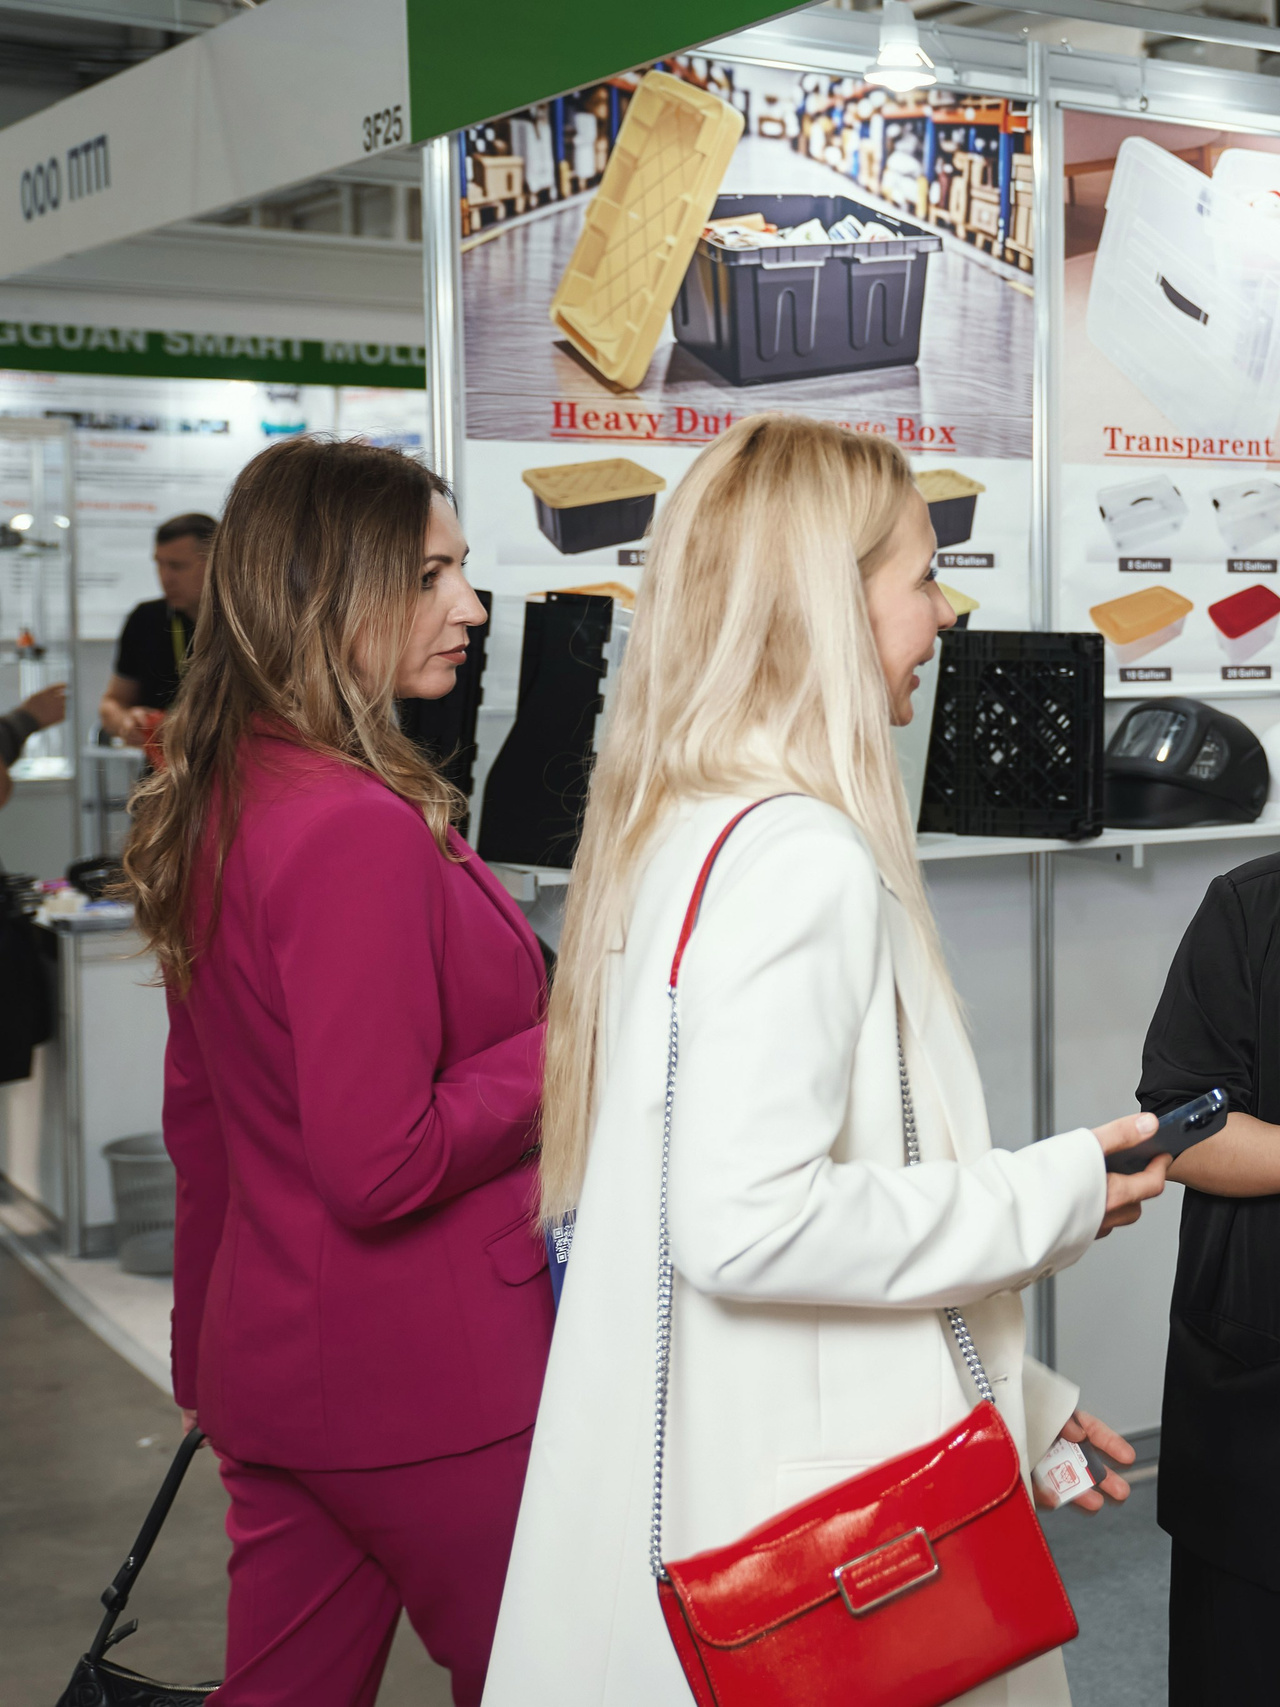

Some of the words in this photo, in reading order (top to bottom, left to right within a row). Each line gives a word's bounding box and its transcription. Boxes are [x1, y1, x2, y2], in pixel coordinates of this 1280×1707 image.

[362, 104, 403, 153] 3F25
[552, 401, 665, 439] Heavy
[674, 405, 740, 435] Dut
[896, 417, 957, 445] Box
[1103, 426, 1276, 460] Transparent
[956, 555, 988, 567] Gallon
